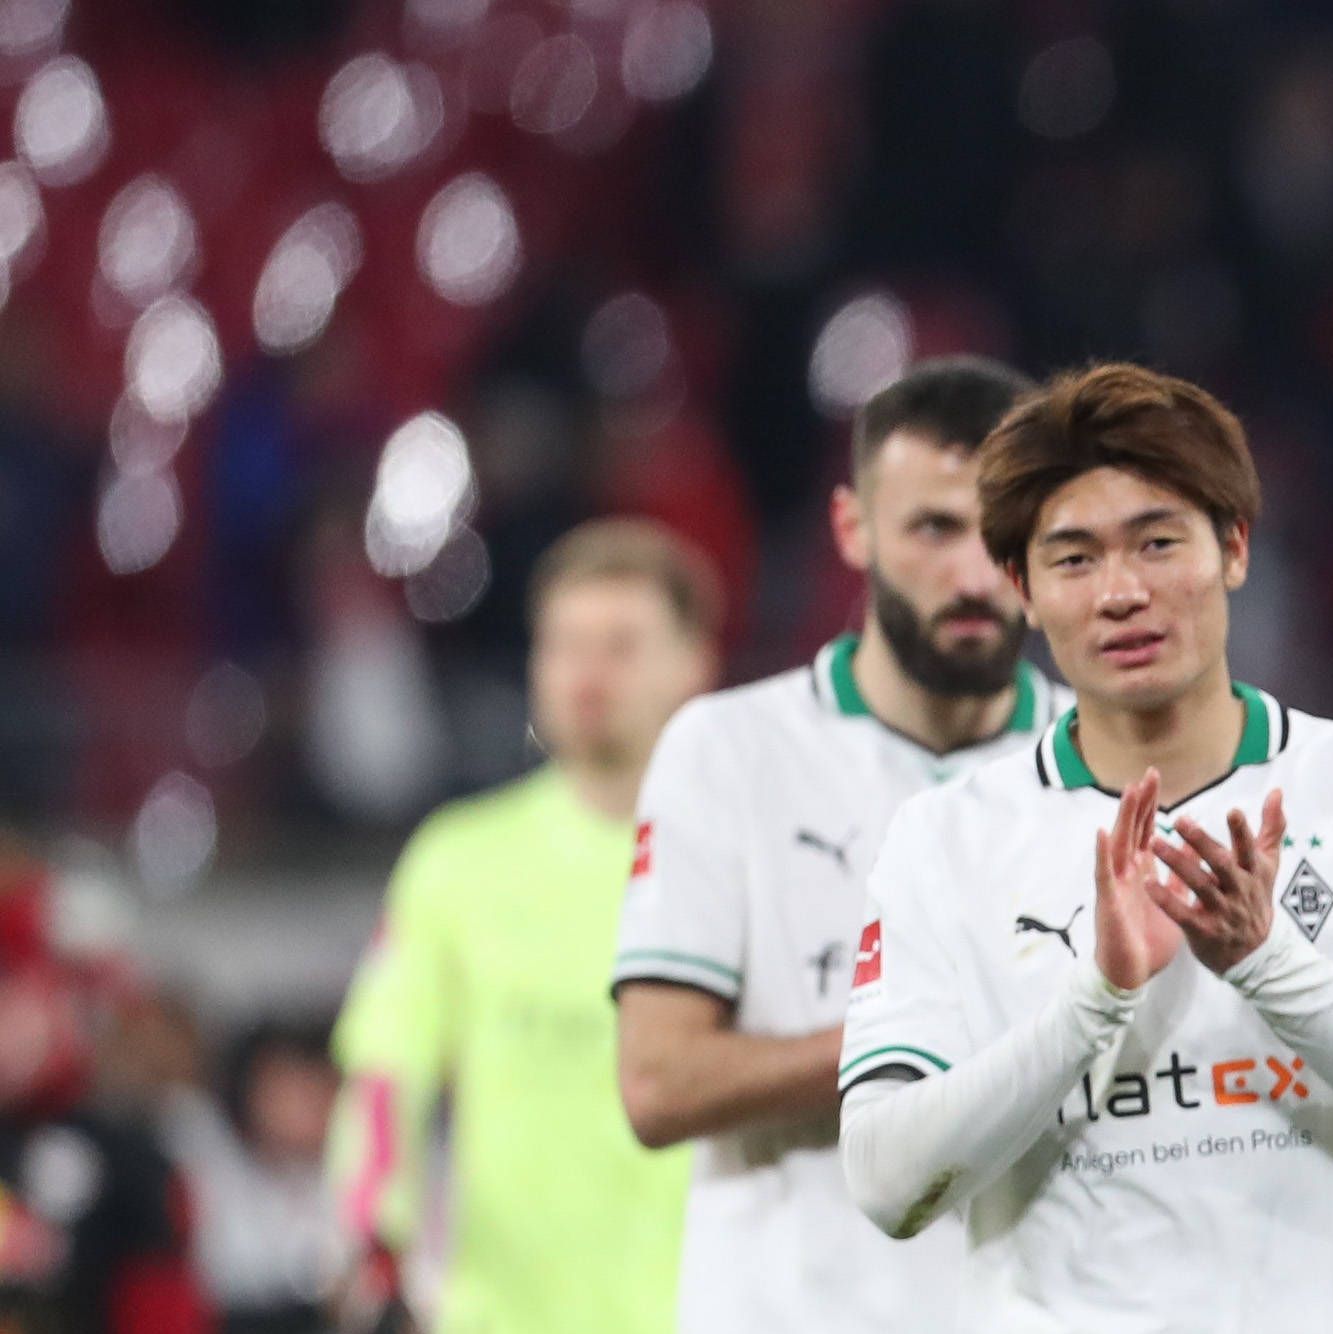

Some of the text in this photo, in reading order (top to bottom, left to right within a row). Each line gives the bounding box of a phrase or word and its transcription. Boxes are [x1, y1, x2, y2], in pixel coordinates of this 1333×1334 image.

[1058, 1052, 1308, 1124] latex
[1153, 1141, 1190, 1163] bei
[1198, 1131, 1244, 1156] den
